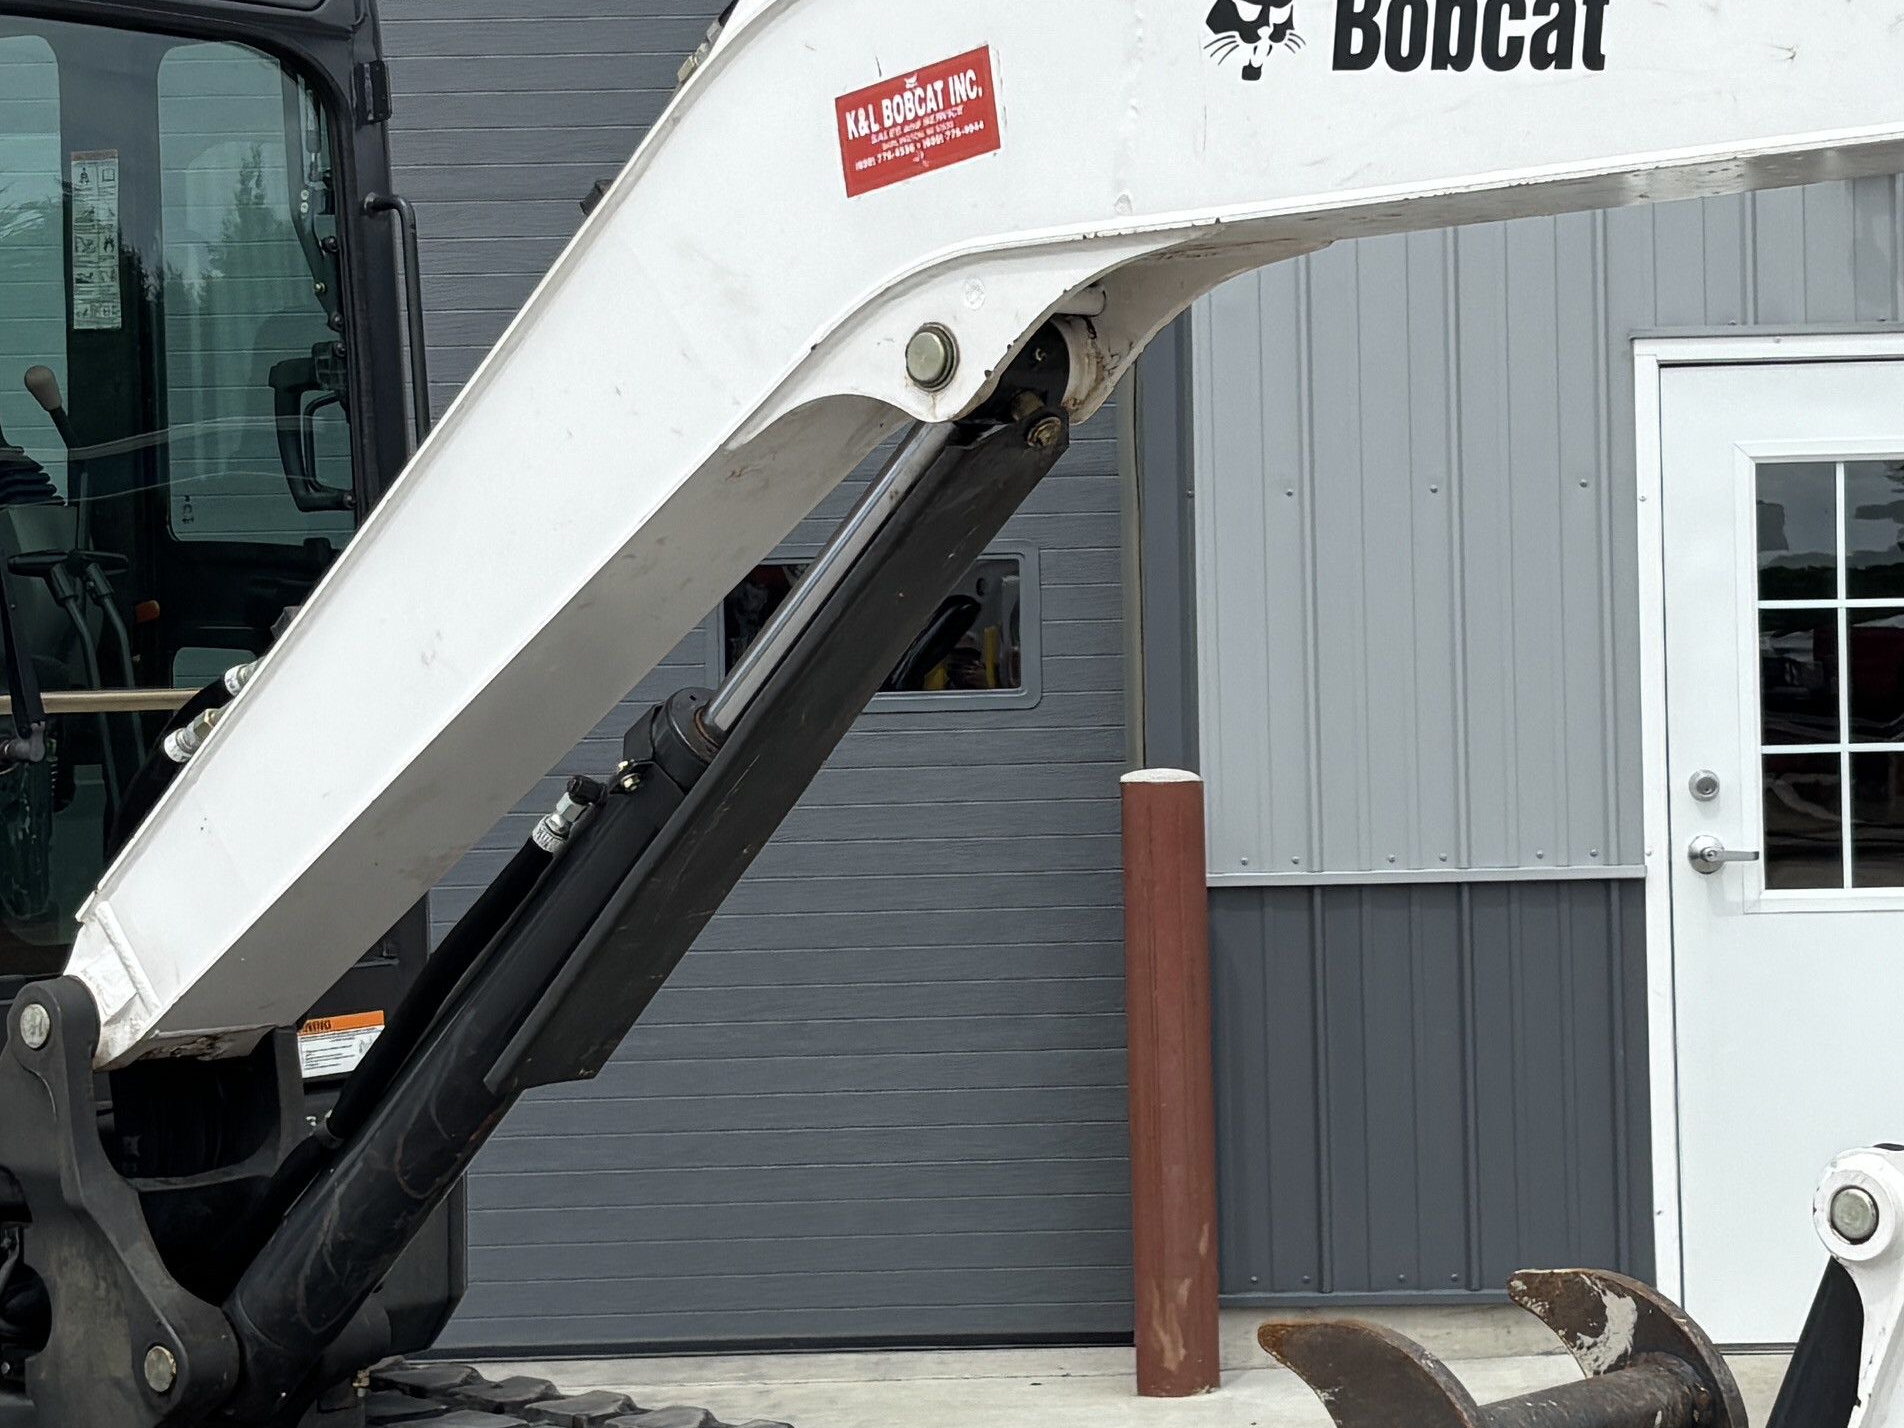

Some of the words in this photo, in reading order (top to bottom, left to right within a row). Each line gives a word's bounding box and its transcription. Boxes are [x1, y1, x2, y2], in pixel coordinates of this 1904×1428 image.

[846, 103, 881, 140] K&L
[881, 79, 945, 128] BOBCAT
[948, 69, 983, 106] INC.
